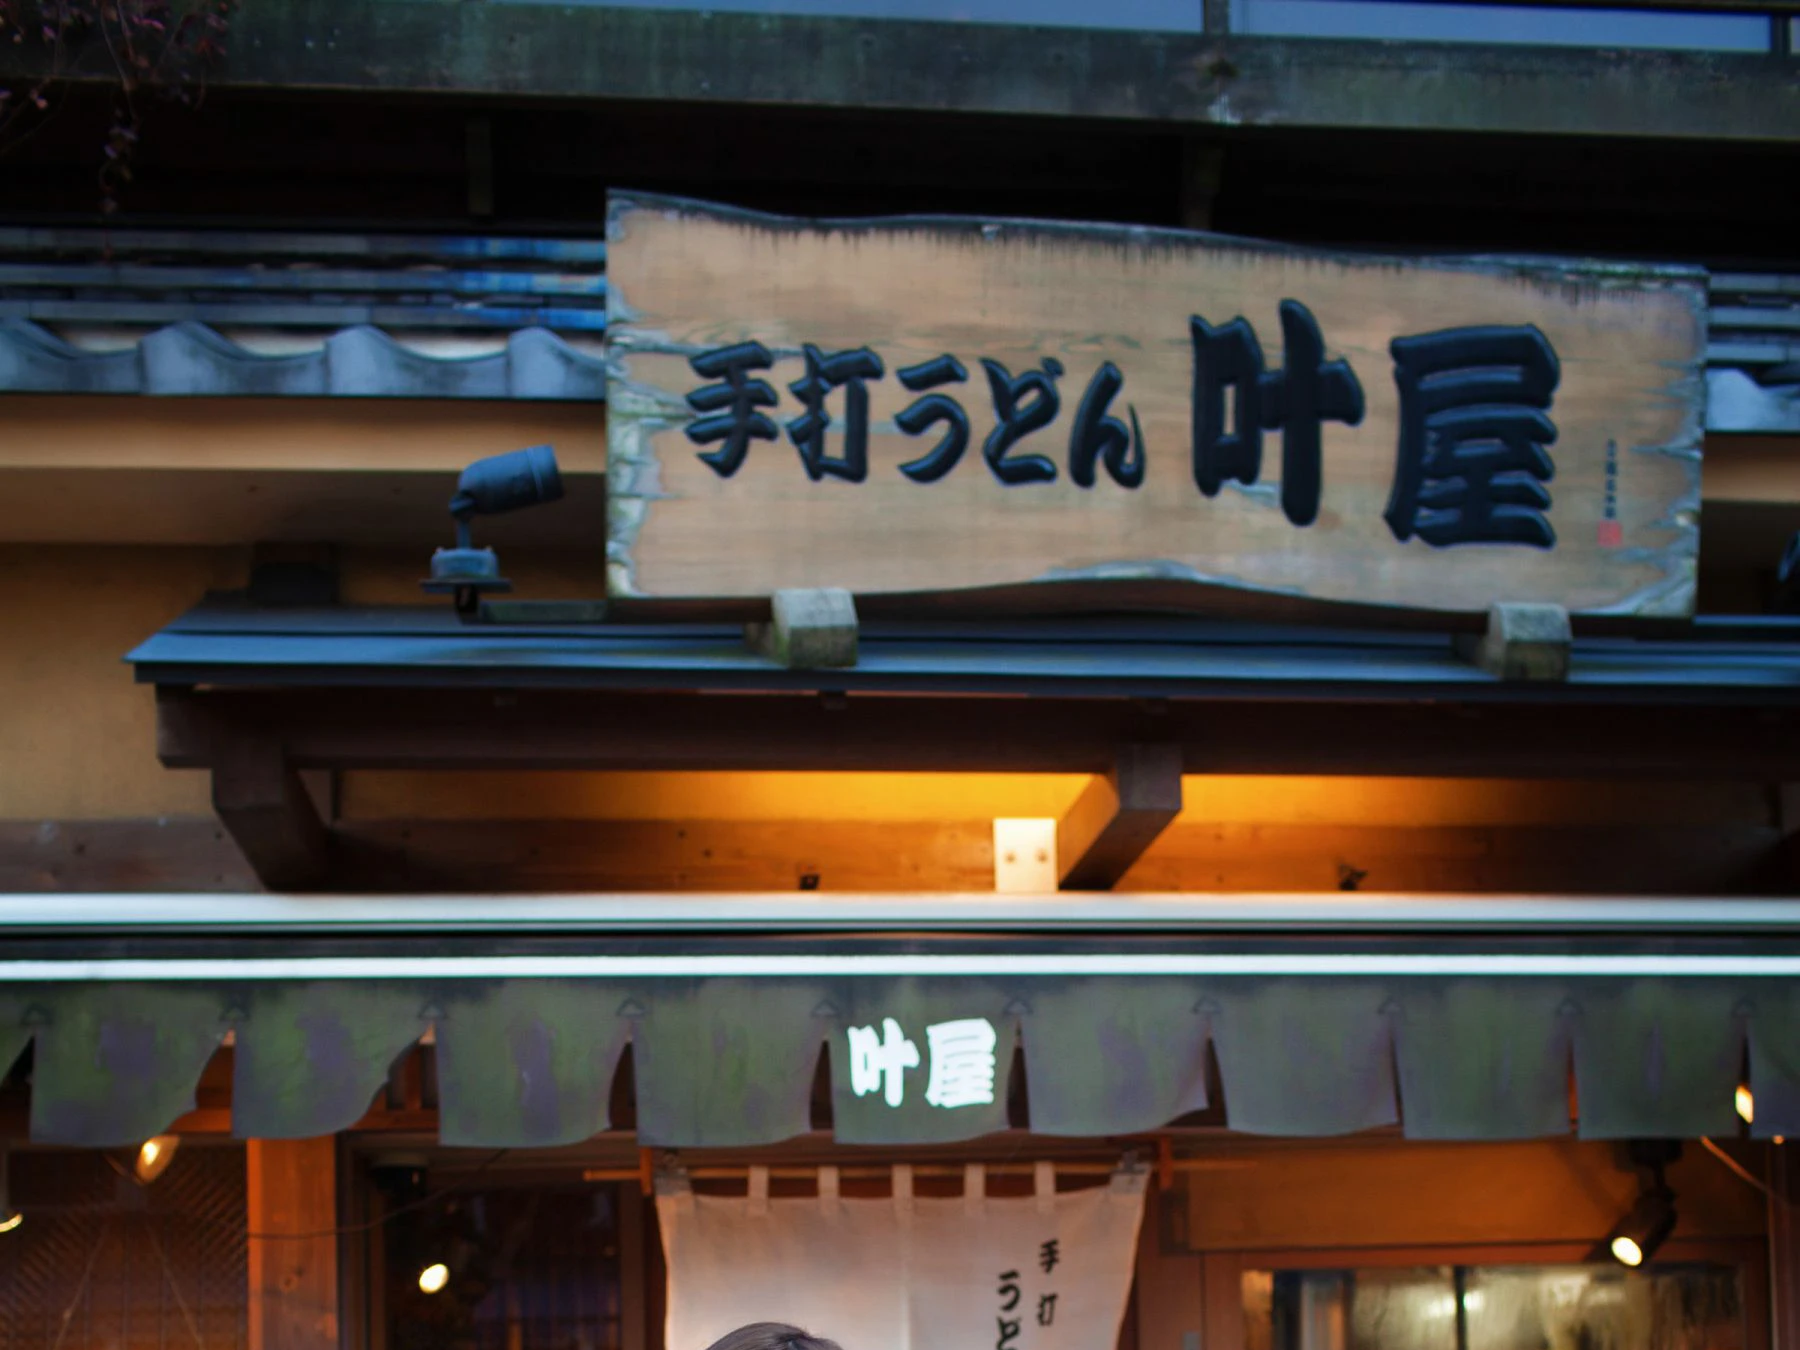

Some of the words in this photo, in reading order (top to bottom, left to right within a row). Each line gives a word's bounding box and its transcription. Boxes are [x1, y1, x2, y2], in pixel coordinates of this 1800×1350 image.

[684, 340, 1146, 489] 手打うどん
[1190, 298, 1561, 551] 叶屋
[847, 1017, 997, 1108] 叶屋
